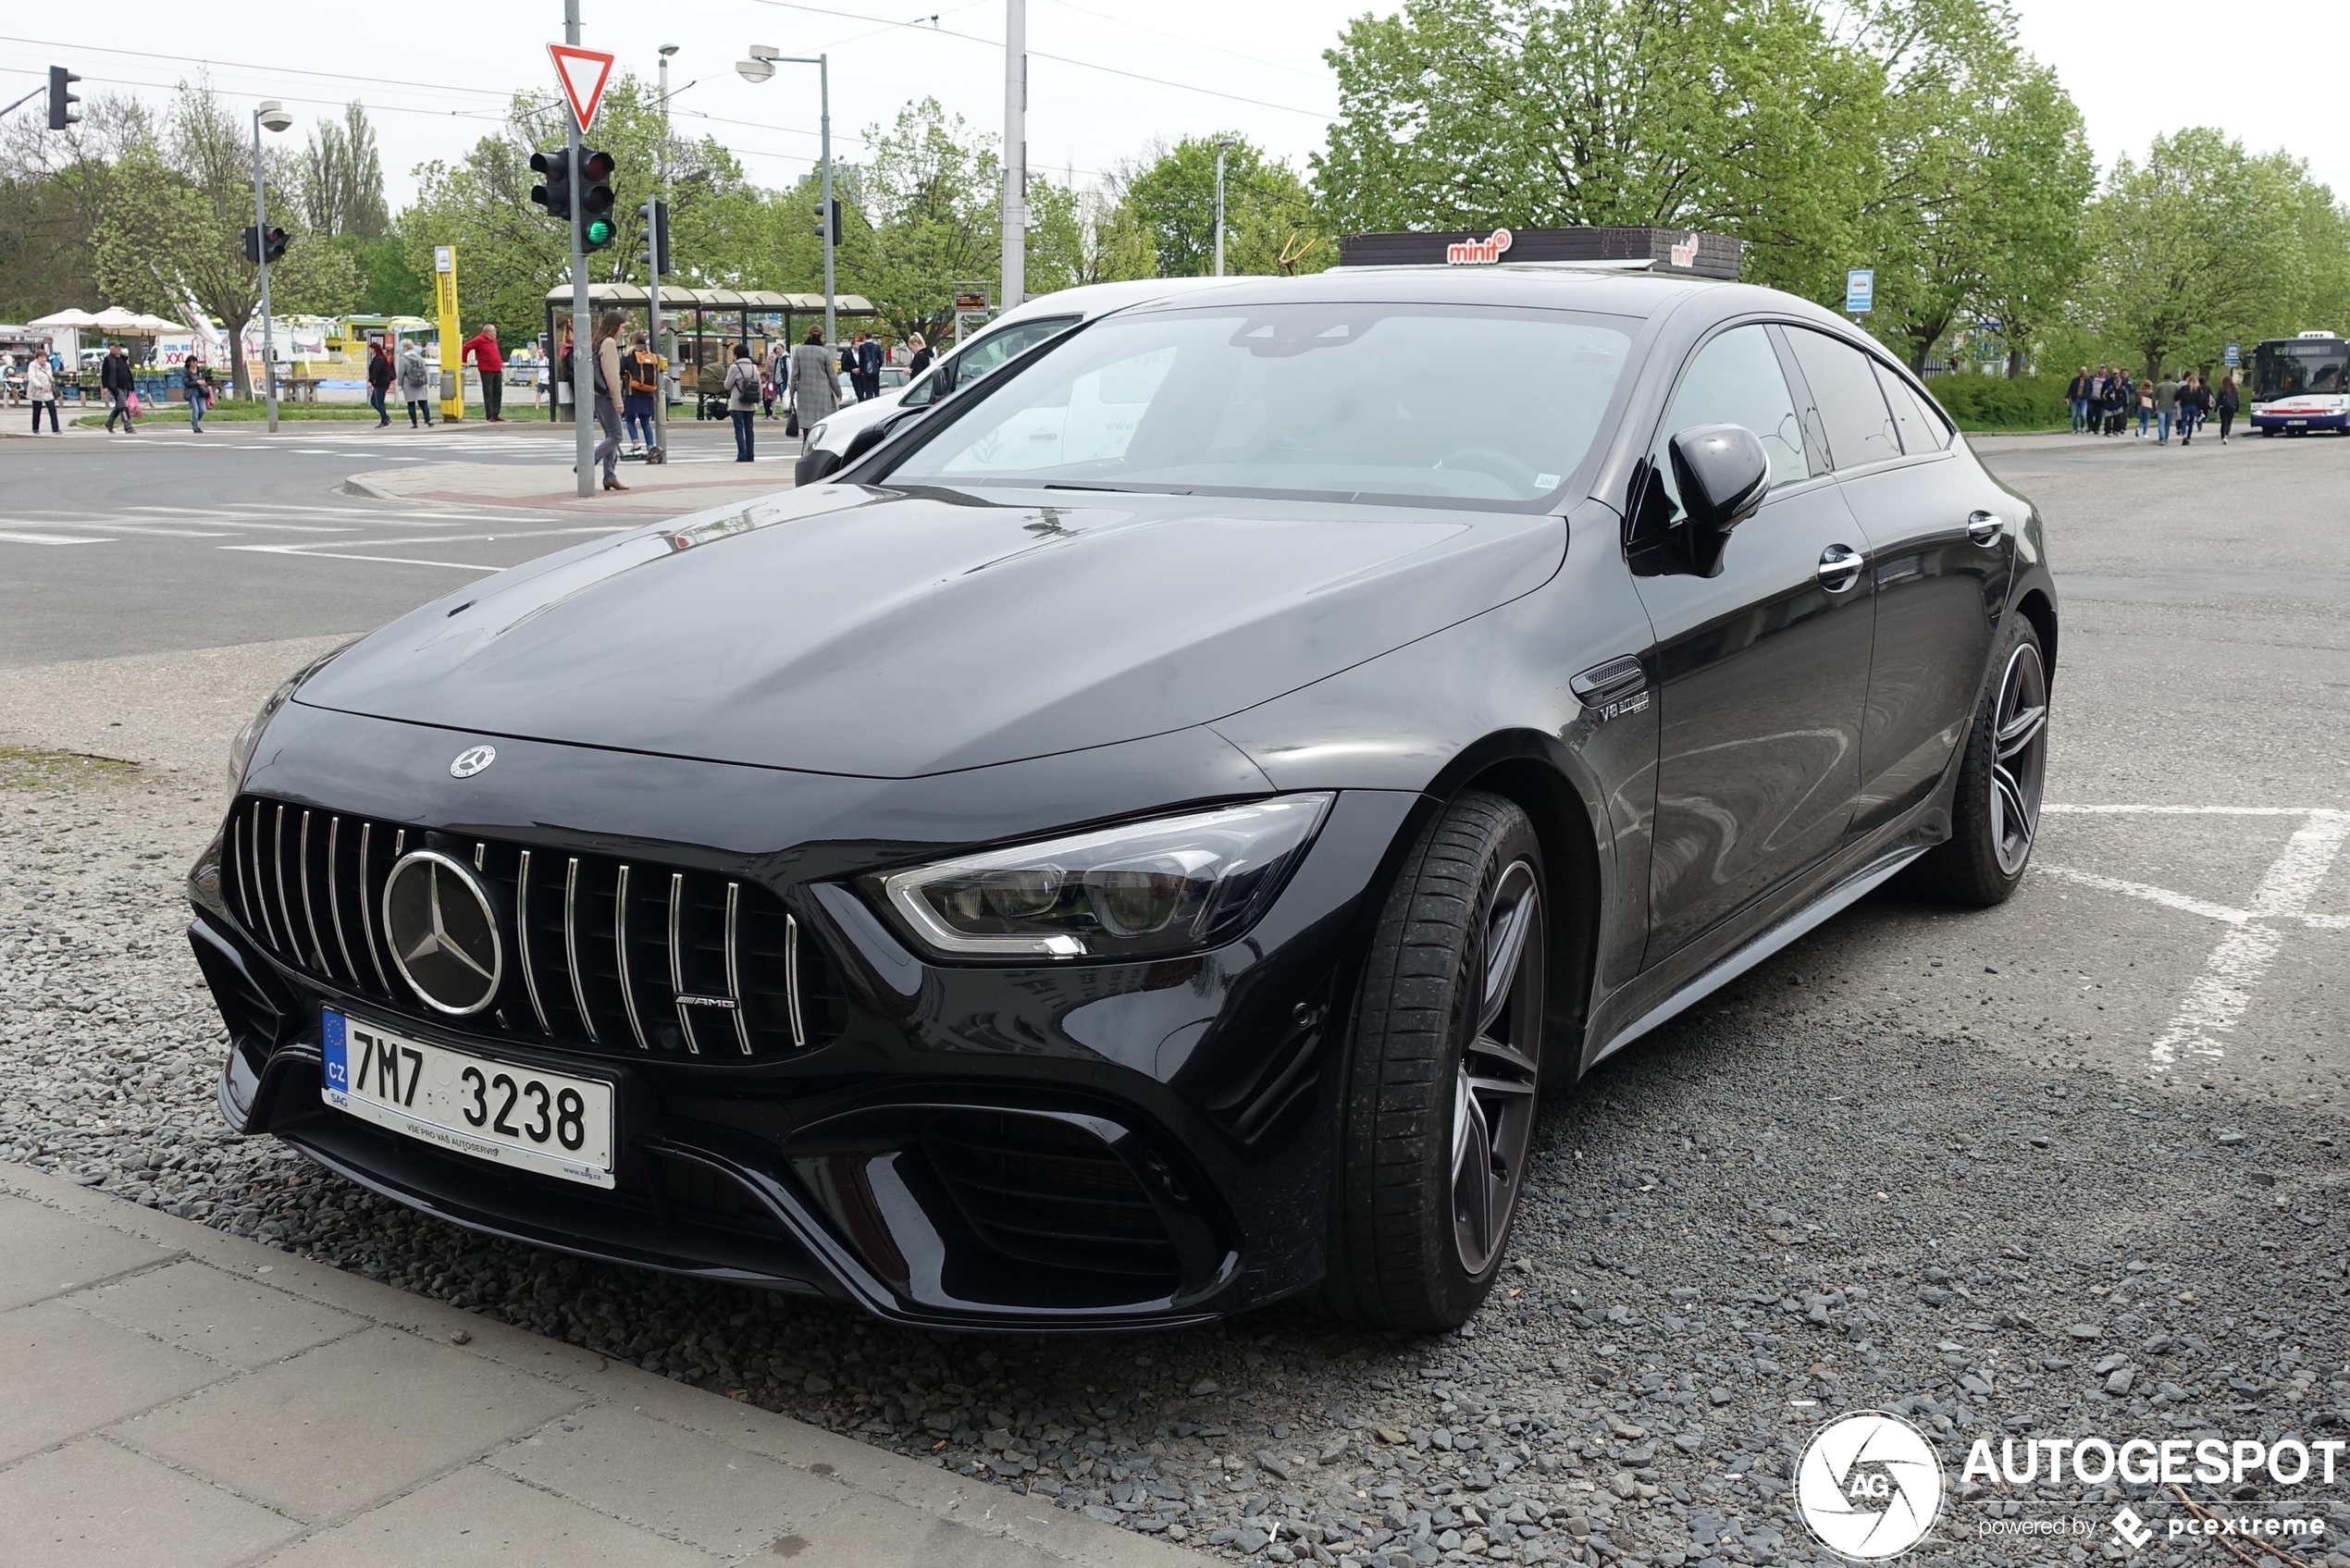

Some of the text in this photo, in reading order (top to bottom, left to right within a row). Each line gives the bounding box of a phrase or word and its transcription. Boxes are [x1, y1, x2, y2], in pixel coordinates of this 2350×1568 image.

[1450, 241, 1498, 262] minit
[165, 352, 185, 364] XXL
[1600, 703, 1618, 722] V8
[1619, 690, 1649, 710] BITURBO
[1453, 848, 1498, 1004] MICHELIN
[694, 997, 735, 1008] AMG
[328, 1061, 346, 1083] CZ
[330, 1093, 348, 1107] SAG
[353, 1030, 585, 1151] 7M7 3238
[406, 1122, 500, 1157] VŠE PRO VÁŠ AUTOSERVIS
[563, 1167, 601, 1180] www.sag.cz
